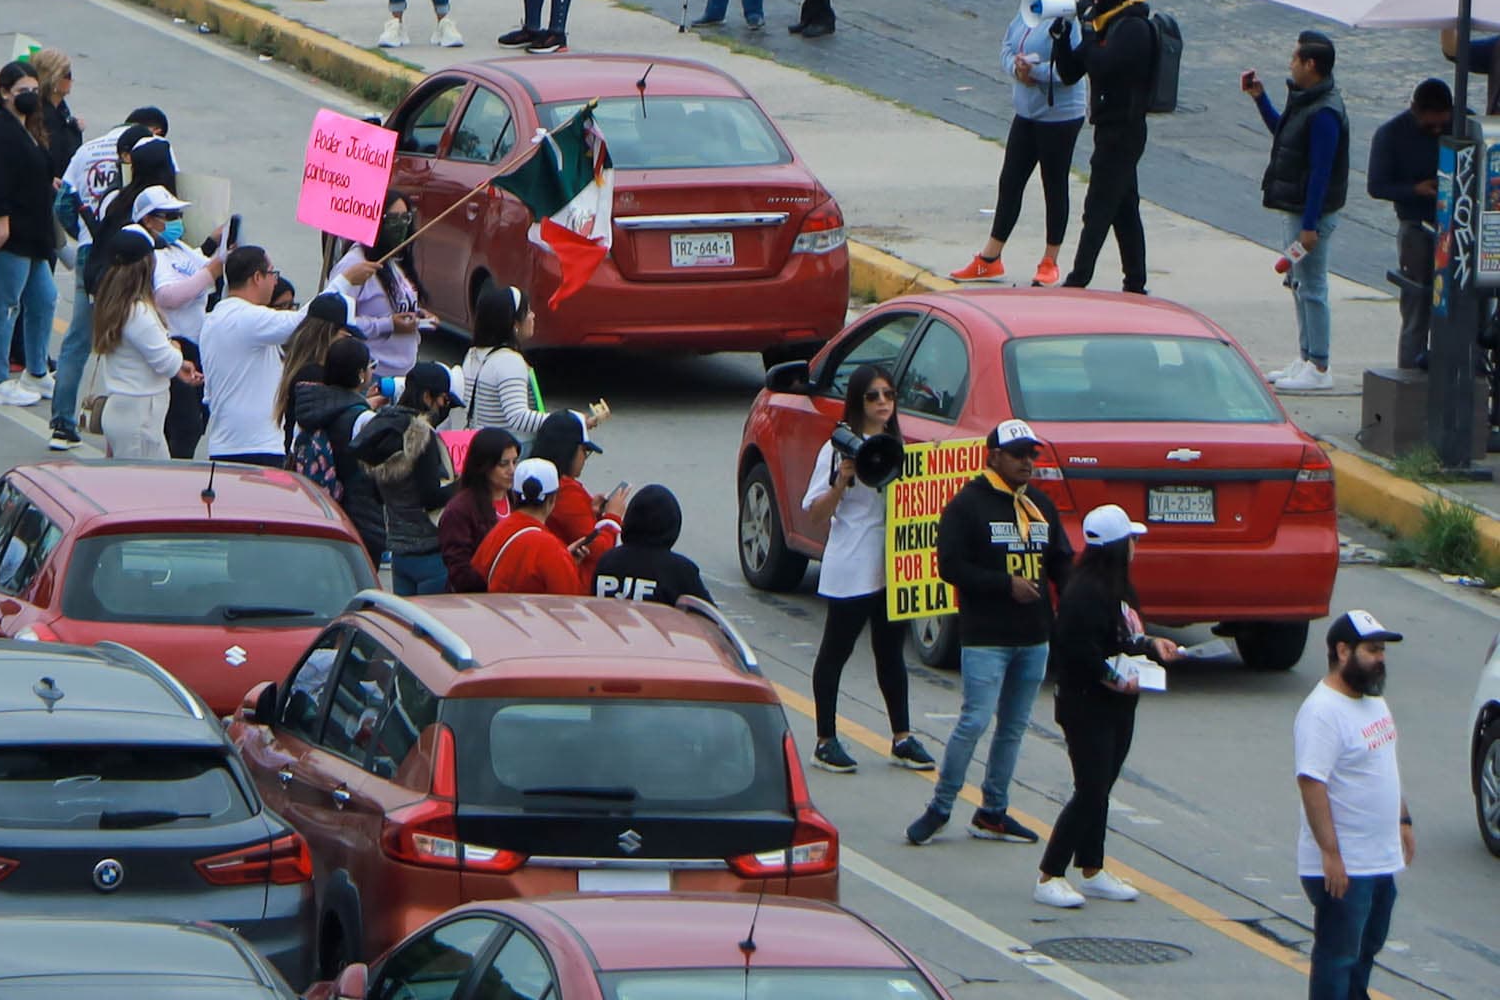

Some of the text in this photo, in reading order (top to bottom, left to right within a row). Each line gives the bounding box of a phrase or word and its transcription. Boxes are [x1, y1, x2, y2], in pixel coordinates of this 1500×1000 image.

[314, 129, 389, 169] Poder Judicial
[674, 241, 732, 256] TRZ-644-A
[894, 476, 971, 520] PRESIDENT
[894, 518, 939, 553] MÉXIC
[894, 553, 923, 583] POR
[1006, 552, 1043, 580] PJF
[596, 574, 657, 602] PJF
[896, 585, 920, 615] DE
[925, 582, 948, 611] LA
